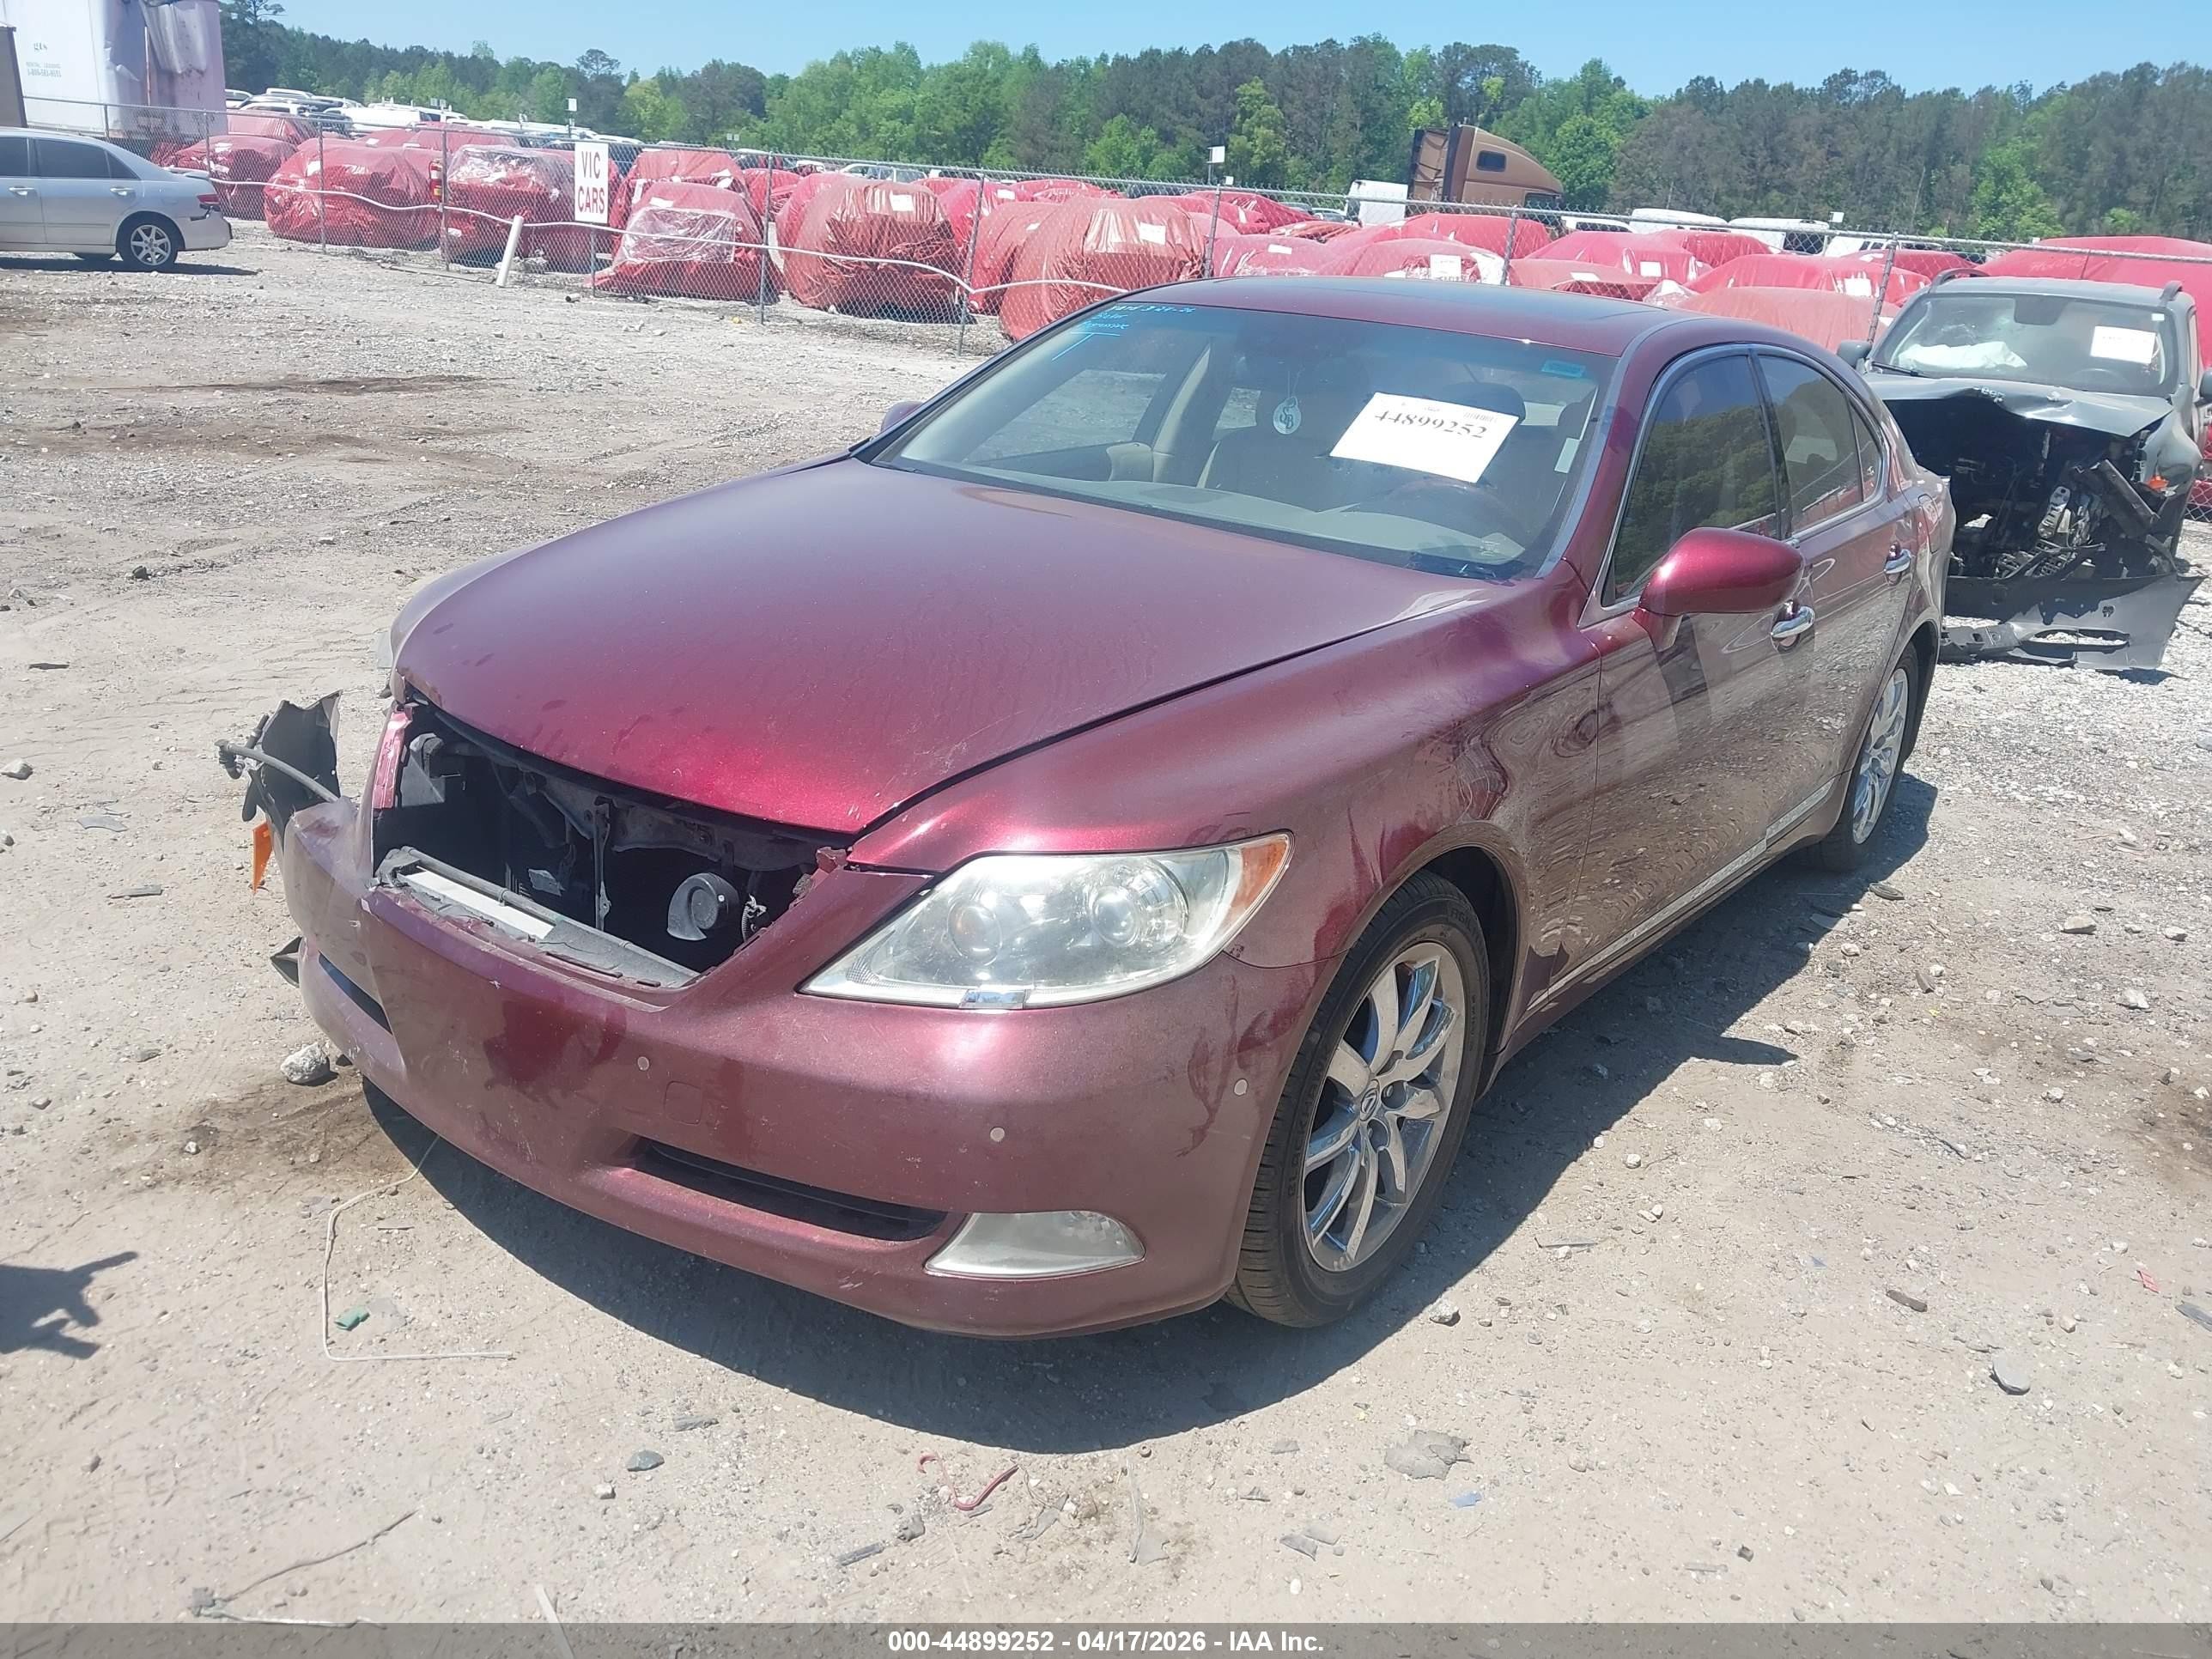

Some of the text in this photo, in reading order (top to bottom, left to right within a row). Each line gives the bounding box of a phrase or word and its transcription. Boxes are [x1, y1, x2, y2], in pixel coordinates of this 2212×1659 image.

[581, 150, 601, 179] VIC
[578, 185, 605, 214] CARS
[1374, 410, 1488, 439] 44899252
